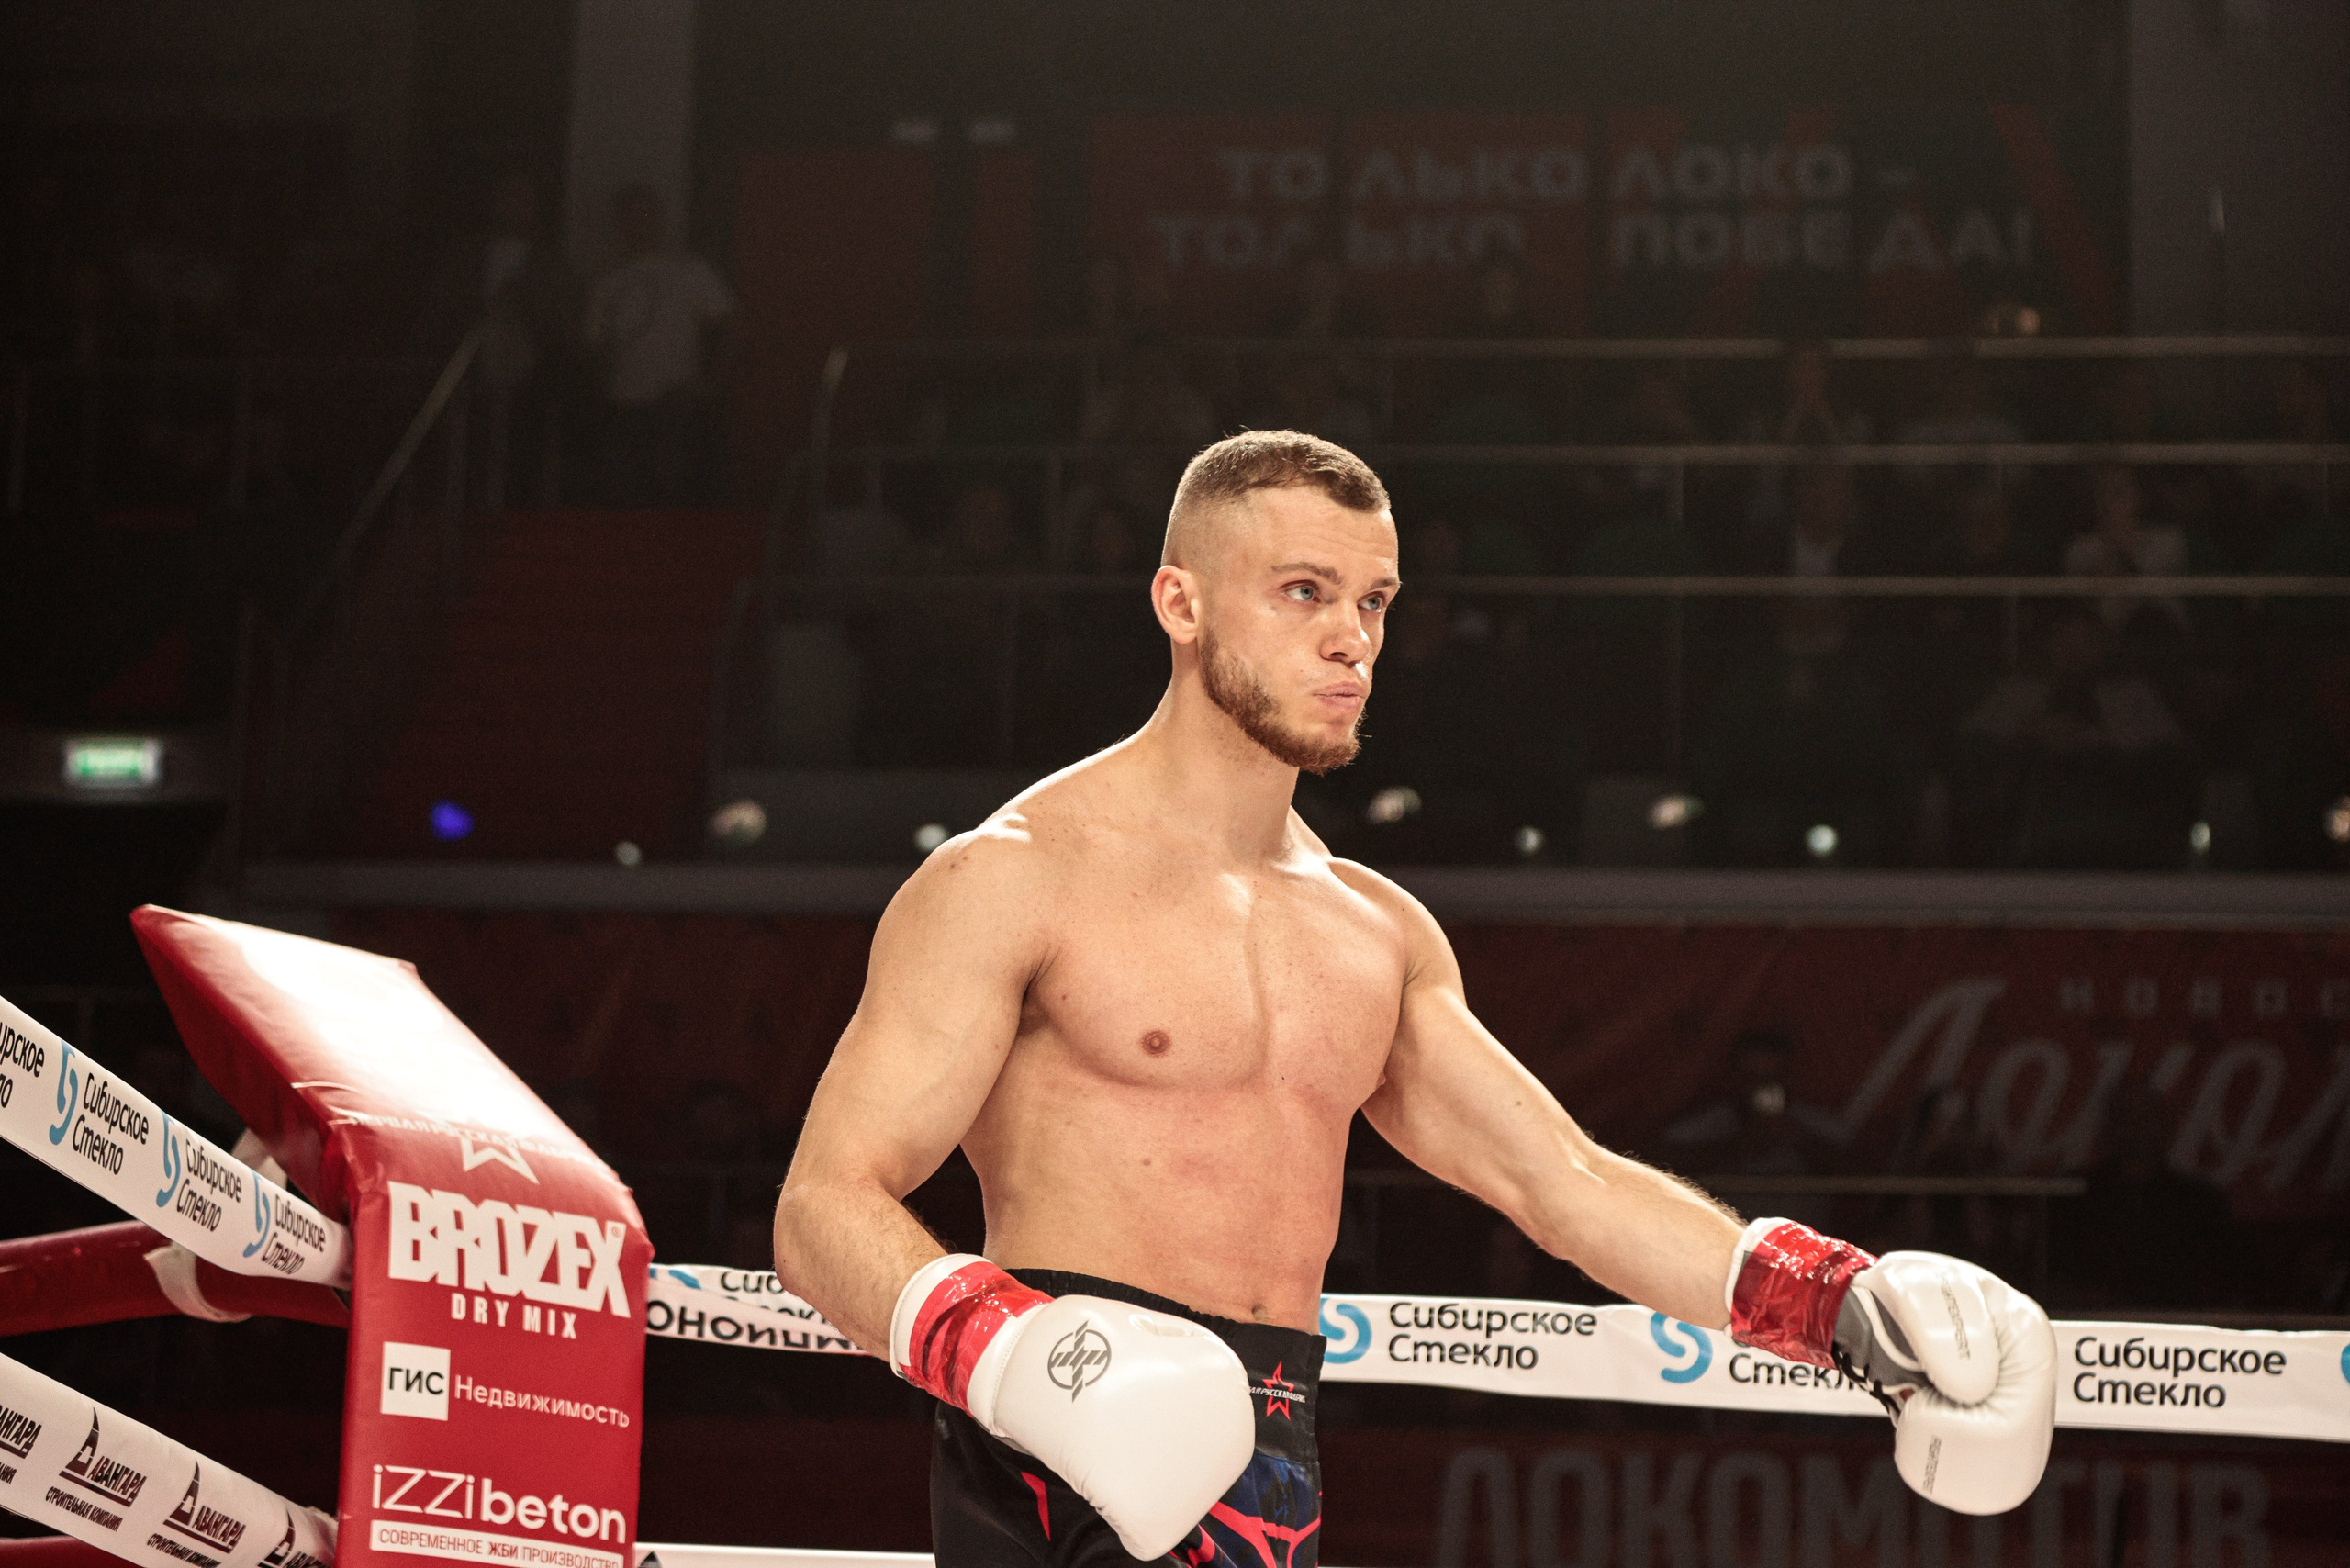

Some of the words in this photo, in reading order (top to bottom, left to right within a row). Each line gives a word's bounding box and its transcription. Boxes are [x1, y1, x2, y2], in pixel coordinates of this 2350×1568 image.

[0, 1021, 45, 1078] ирское
[83, 1072, 150, 1145] Сибирское
[73, 1114, 124, 1175] Стекло
[185, 1138, 242, 1203] Сибирское
[176, 1178, 222, 1232] Стекло
[275, 1193, 327, 1252] Сибирское
[261, 1231, 305, 1275] Стекло
[386, 1180, 631, 1318] BROZEX
[451, 1292, 509, 1327] DRY
[522, 1304, 577, 1339] MIX
[1389, 1301, 1598, 1339] Сибирское
[1388, 1333, 1539, 1370] Стекло
[2074, 1336, 2287, 1377] Сибирское
[388, 1366, 445, 1395] ГИС
[453, 1374, 630, 1428] Недвижимость
[2073, 1372, 2227, 1408] Стекло
[0, 1405, 42, 1450] АНГАРД
[87, 1455, 147, 1500] АВАНГАРД
[192, 1505, 246, 1549] АВАНГАРД
[378, 1528, 484, 1555] СОВРЕМЕННОЕ
[488, 1541, 519, 1560] ЖБИ
